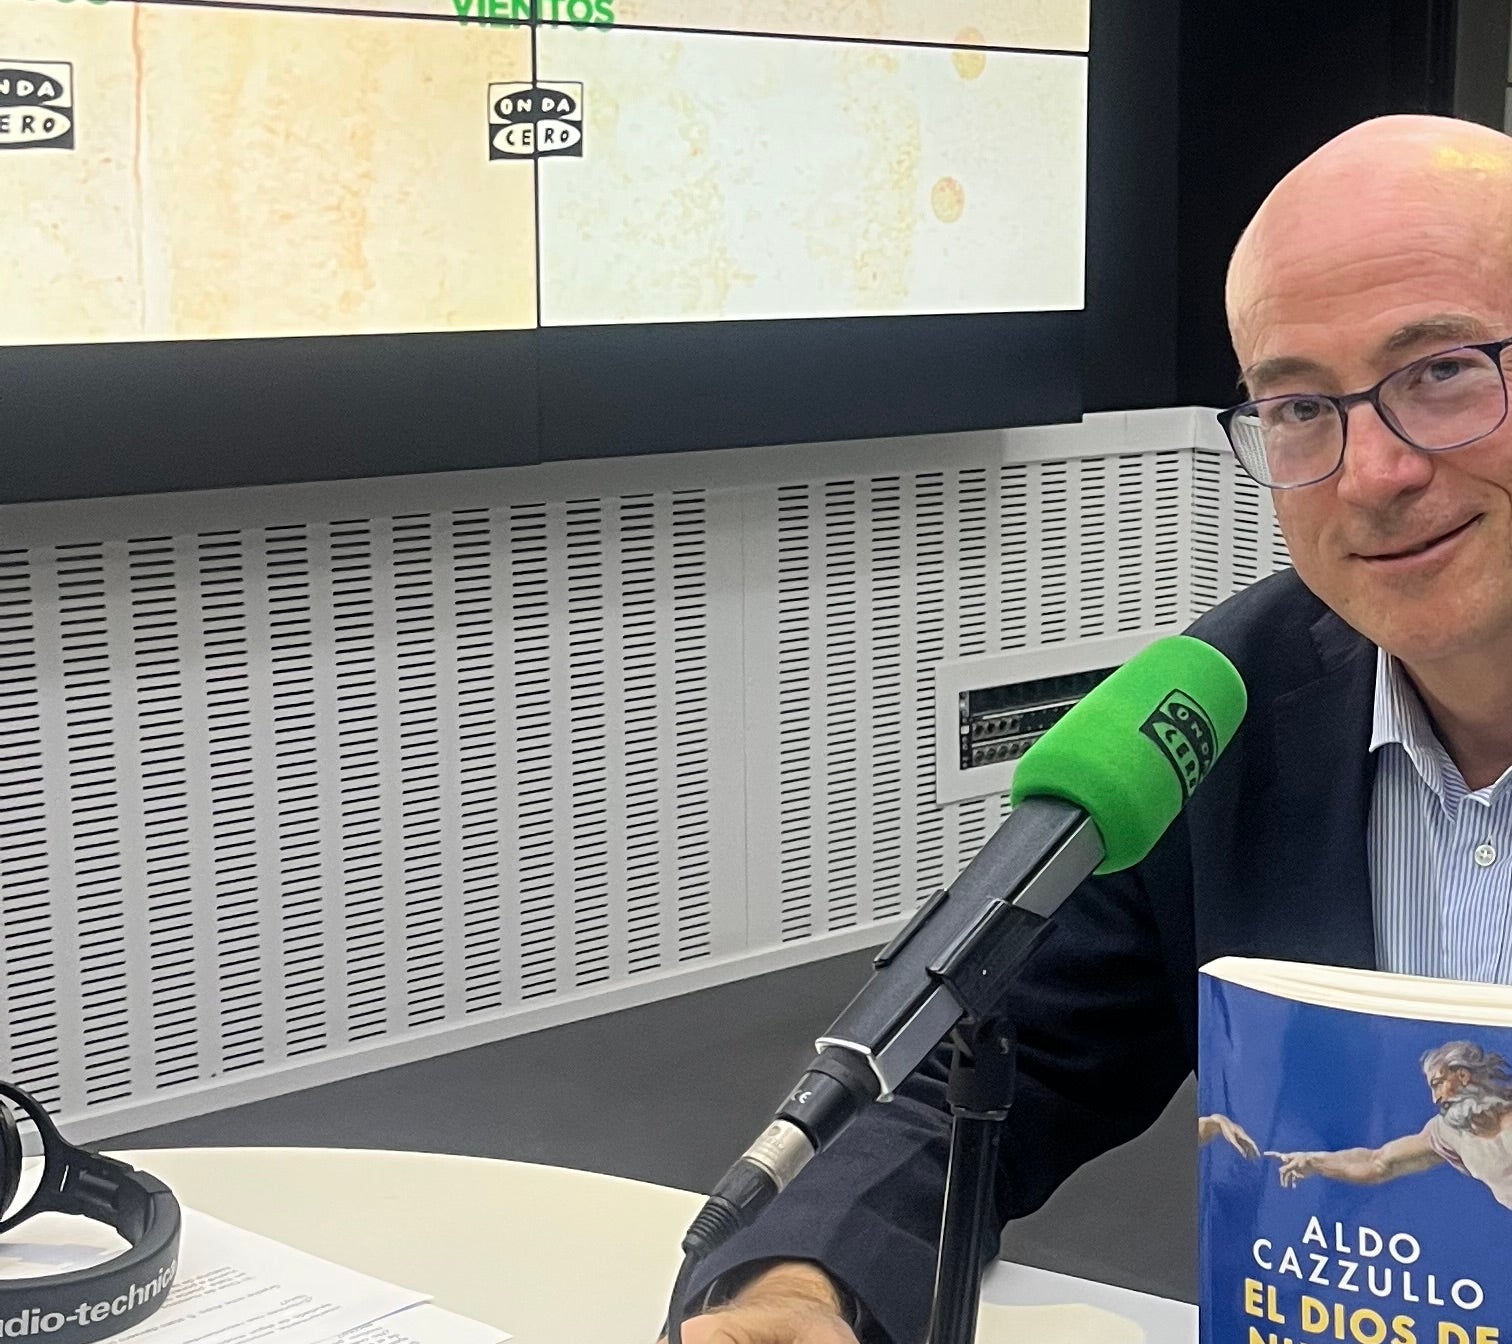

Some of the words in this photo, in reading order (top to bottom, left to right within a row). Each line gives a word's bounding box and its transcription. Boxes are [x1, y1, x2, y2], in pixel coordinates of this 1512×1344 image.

[500, 97, 571, 116] ONDA
[505, 127, 570, 147] CERO
[1302, 1216, 1421, 1264] ALDO
[1252, 1238, 1485, 1311] CAZZULLO
[1244, 1277, 1286, 1325] EL
